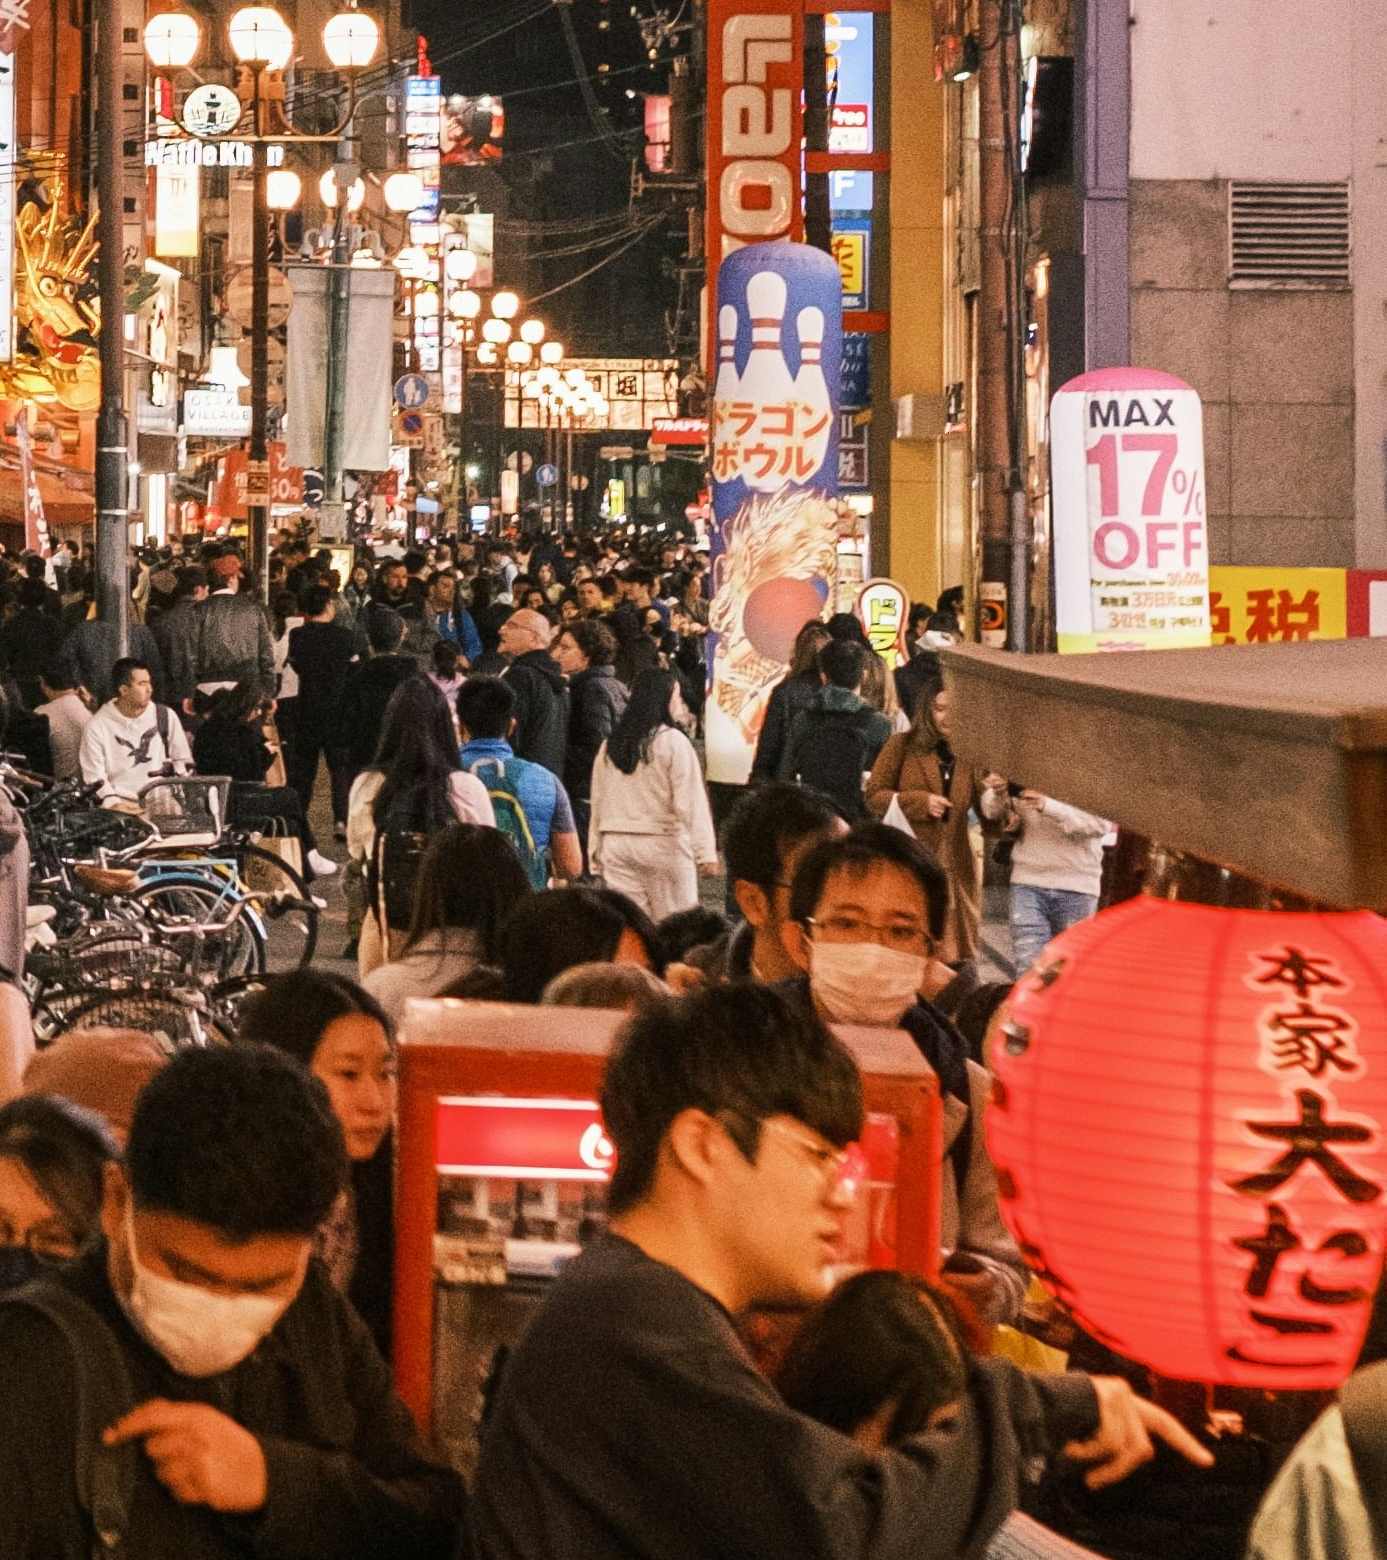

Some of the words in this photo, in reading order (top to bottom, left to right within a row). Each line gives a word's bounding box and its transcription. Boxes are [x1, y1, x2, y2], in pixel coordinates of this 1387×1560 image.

[219, 141, 285, 167] Khn
[714, 401, 831, 441] ドラゴン
[1089, 398, 1176, 429] MAX
[713, 440, 816, 482] ボウル
[1085, 434, 1203, 518] 17%
[1093, 521, 1203, 570] OFF
[1226, 945, 1386, 1371] 本家大たこ
